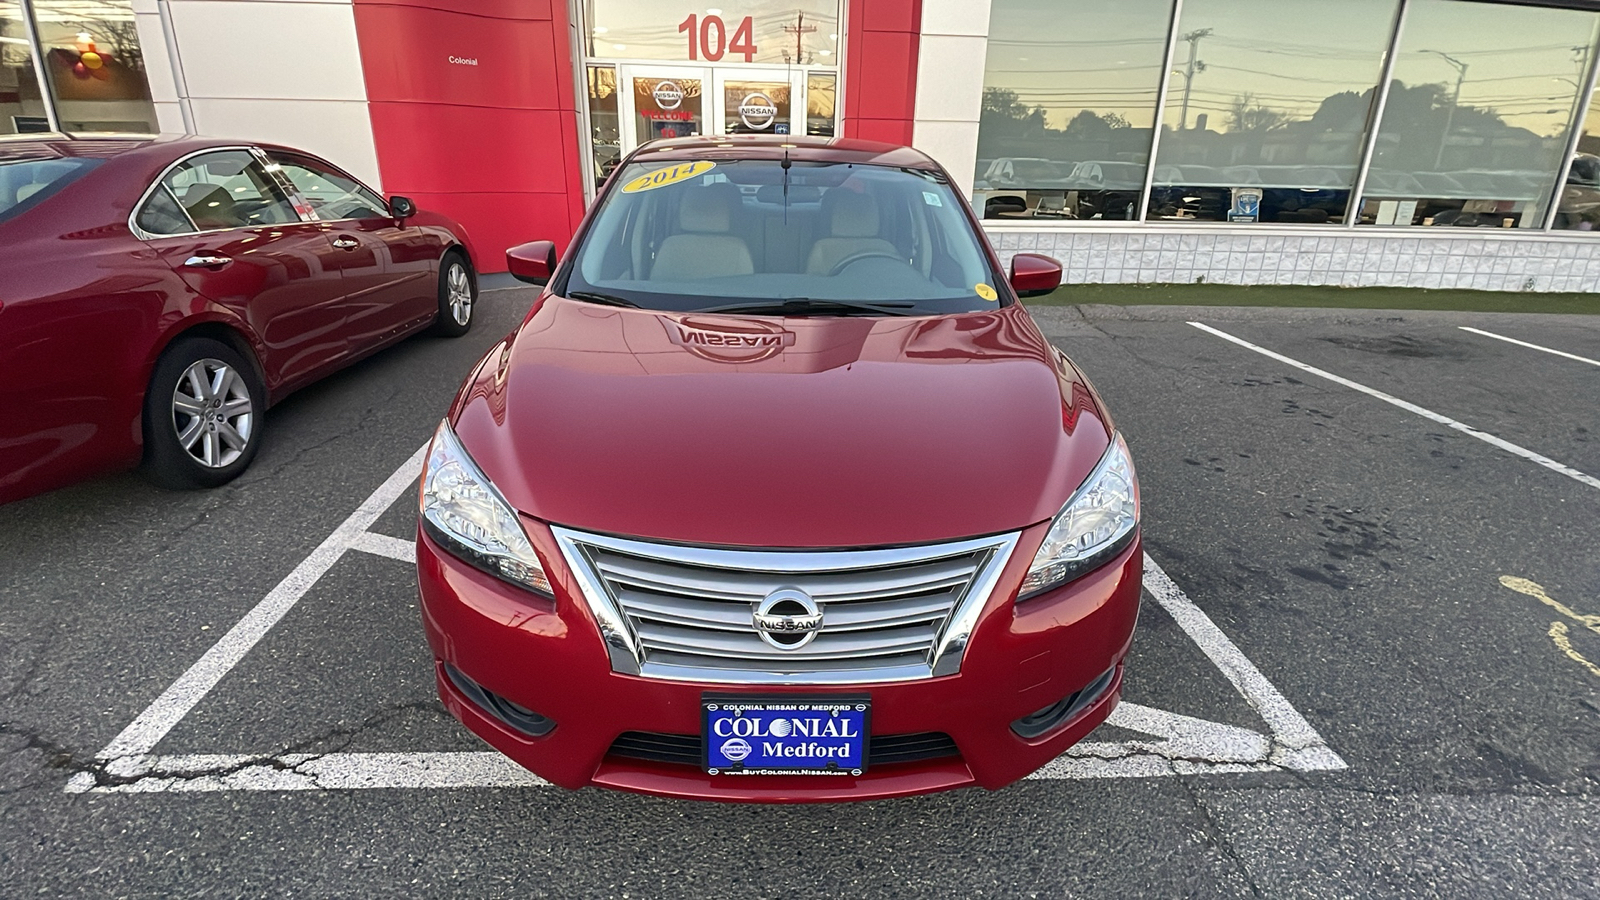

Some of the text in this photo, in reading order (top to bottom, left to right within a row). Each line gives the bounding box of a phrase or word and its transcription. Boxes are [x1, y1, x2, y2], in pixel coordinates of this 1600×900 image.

[678, 13, 758, 63] 104
[448, 55, 479, 66] Colonial
[641, 109, 694, 121] WELCOME
[741, 107, 774, 115] NISSAN
[638, 163, 696, 190] 2014
[760, 620, 816, 631] NISSAN
[713, 717, 858, 738] COLONIAL
[762, 741, 850, 758] Medford
